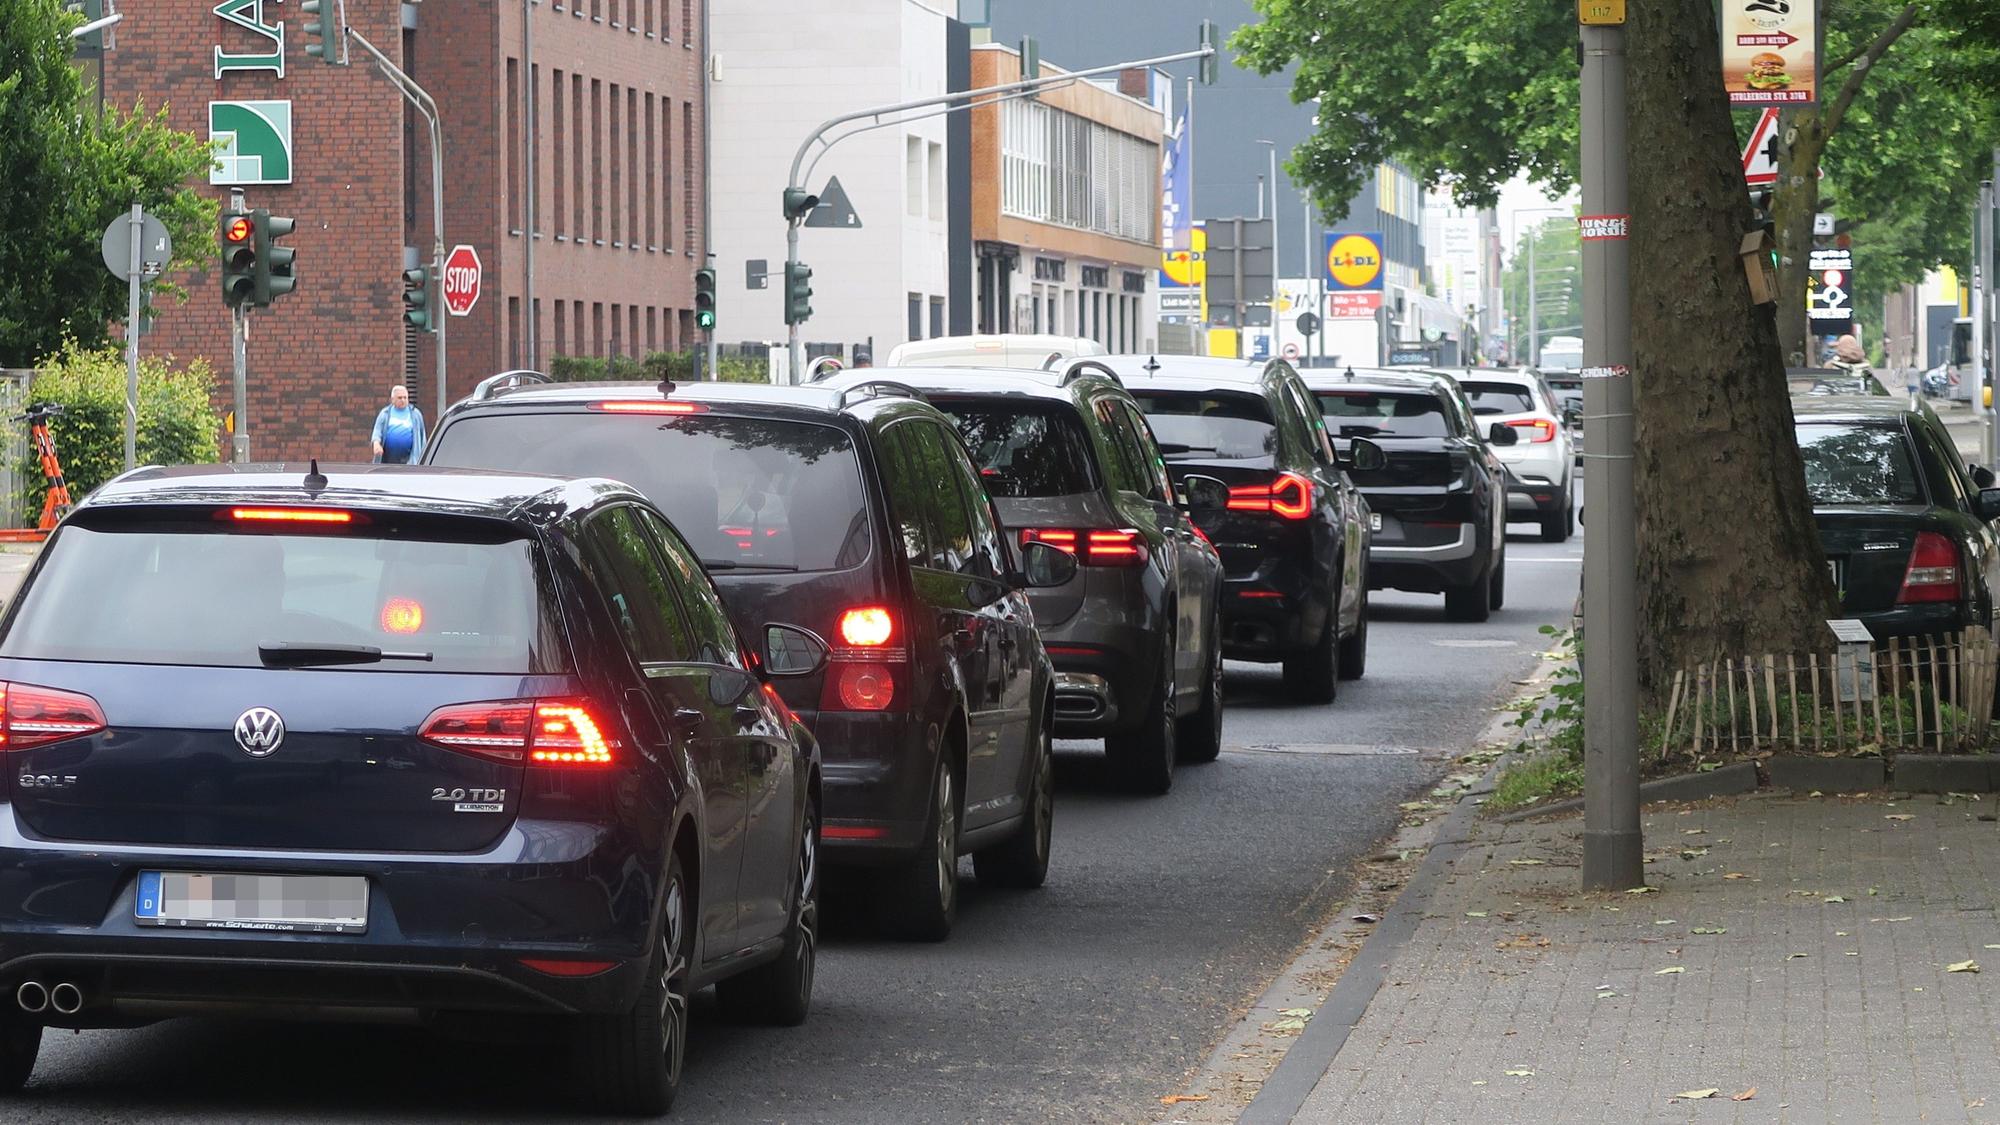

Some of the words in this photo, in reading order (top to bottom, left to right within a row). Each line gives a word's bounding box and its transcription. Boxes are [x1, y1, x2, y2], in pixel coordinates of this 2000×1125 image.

[446, 267, 477, 294] STOP
[19, 774, 78, 788] GOLF
[431, 787, 466, 801] 2.0
[468, 788, 506, 801] TDI
[144, 898, 152, 909] D
[205, 920, 294, 931] www.Schauerte.com
